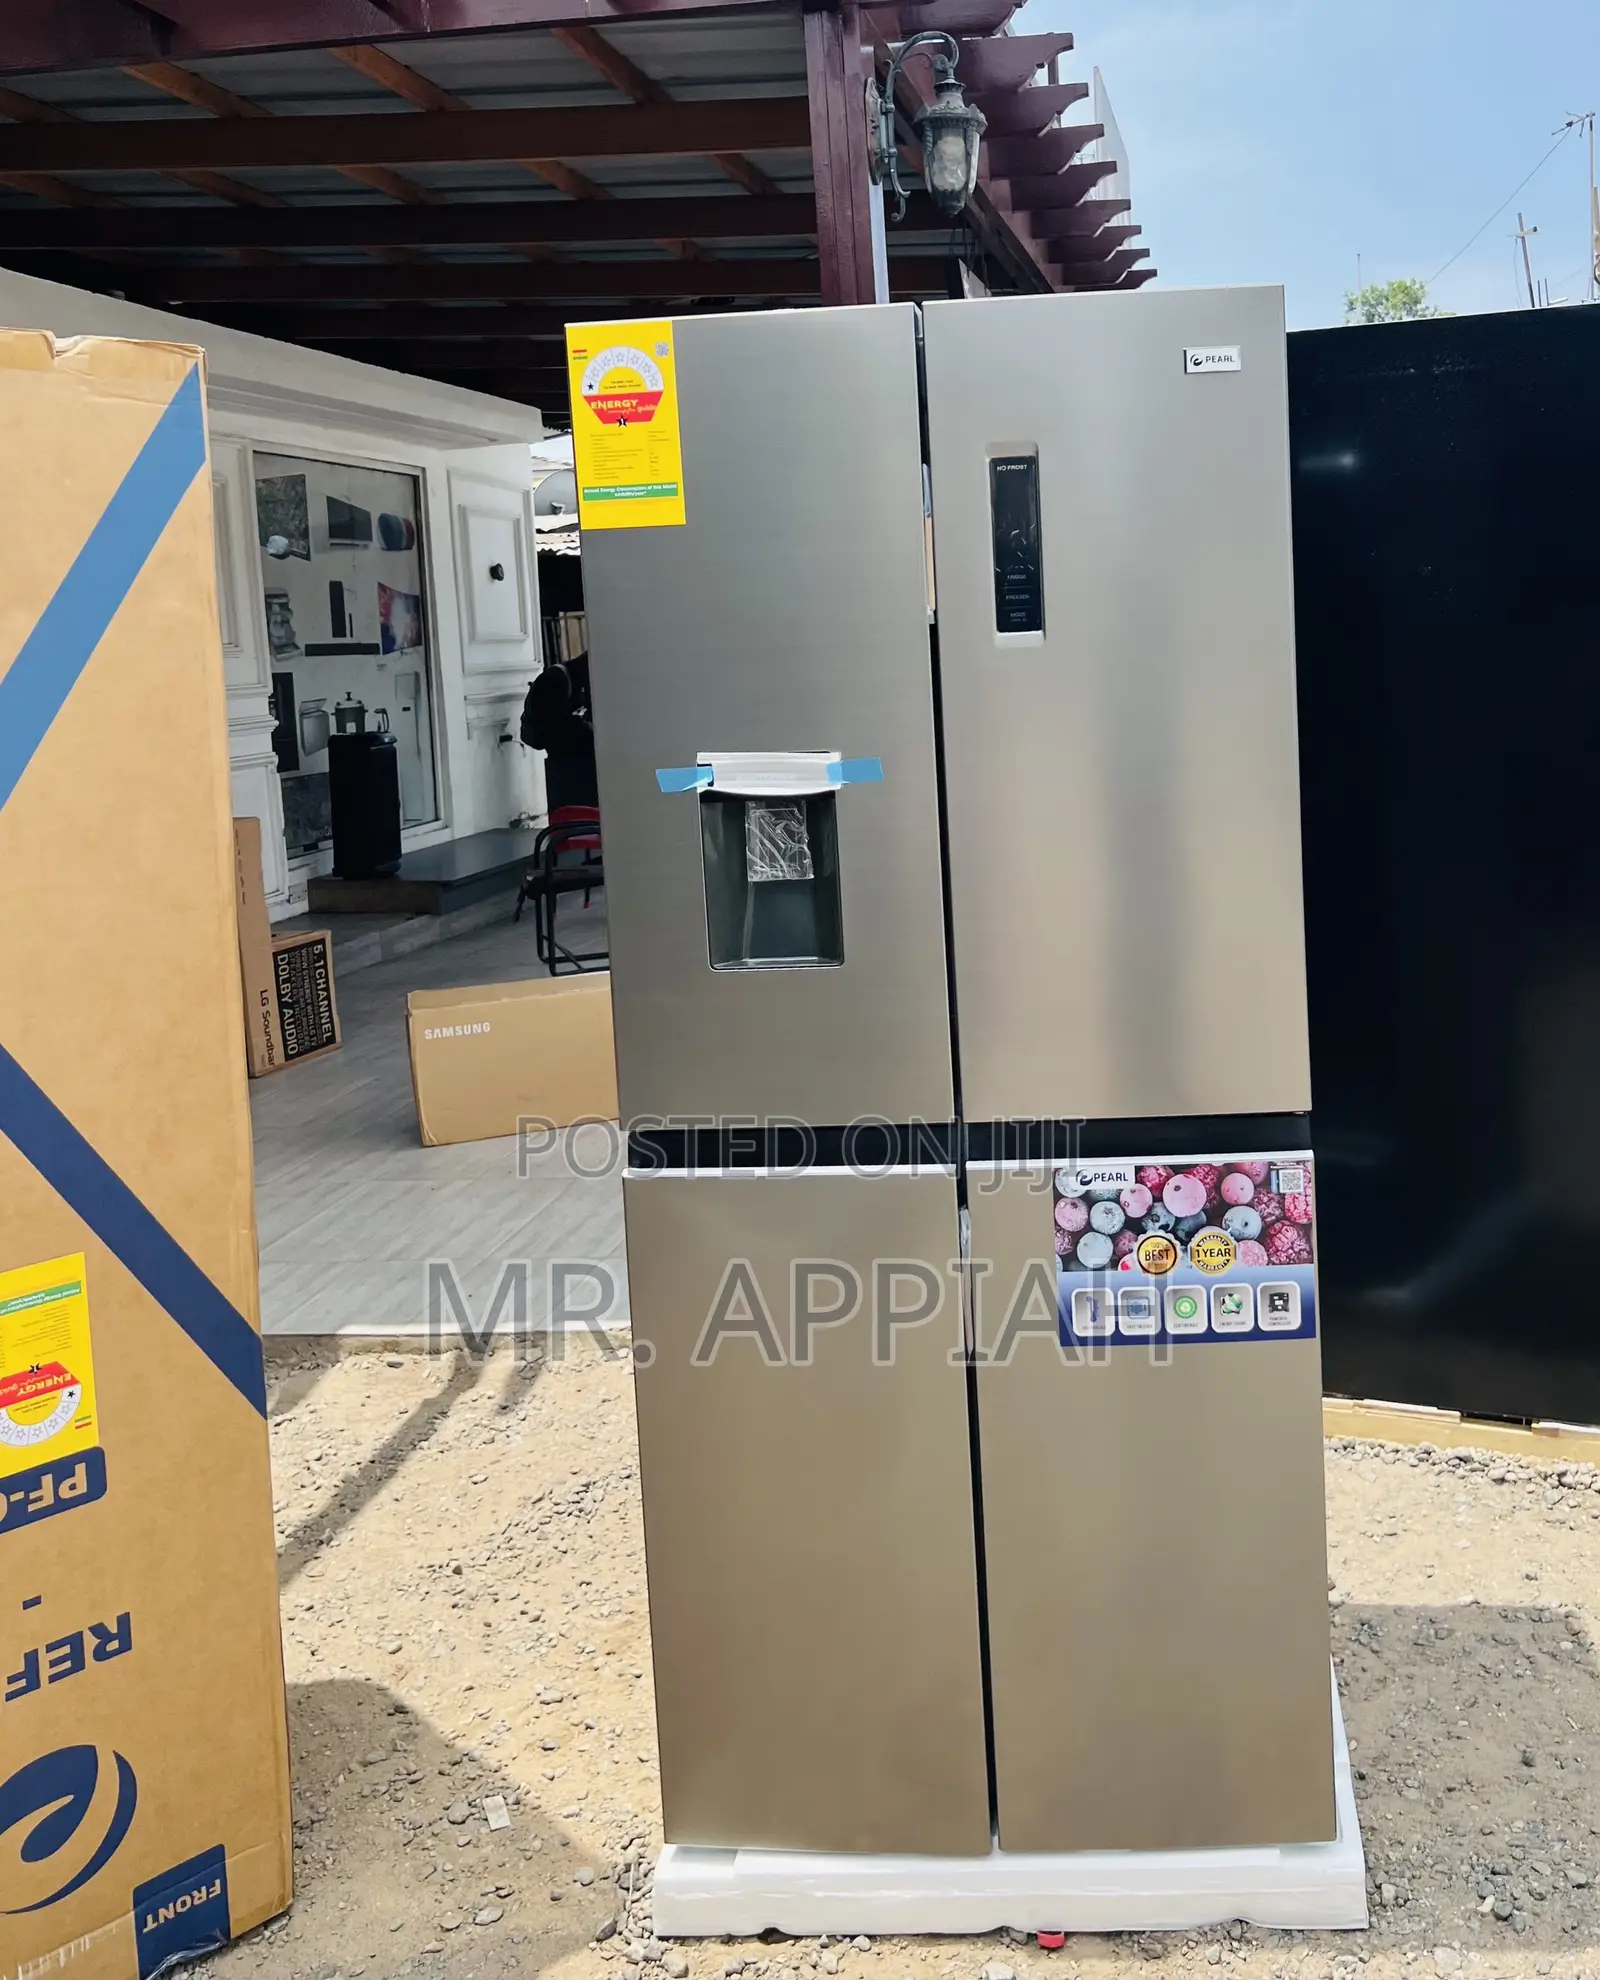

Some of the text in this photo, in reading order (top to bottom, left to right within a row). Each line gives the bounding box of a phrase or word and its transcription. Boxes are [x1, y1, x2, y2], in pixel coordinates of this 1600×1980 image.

[1205, 355, 1236, 363] PEARL
[590, 399, 639, 411] ENERGY
[260, 989, 269, 1007] LG
[277, 953, 299, 1055] DOLBY AUDIO
[306, 1004, 314, 1025] WITH
[262, 1011, 275, 1066] Soundbar
[425, 1022, 491, 1040] SAMSUNG
[1094, 1172, 1129, 1183] PEARL
[1197, 1235, 1230, 1247] WARRANTY
[1145, 1249, 1170, 1261] BEST
[1197, 1258, 1230, 1271] WARRANTY
[17, 1372, 72, 1397] ENERGY
[5, 1611, 133, 1701] REF
[142, 1878, 222, 1934] FRONT
